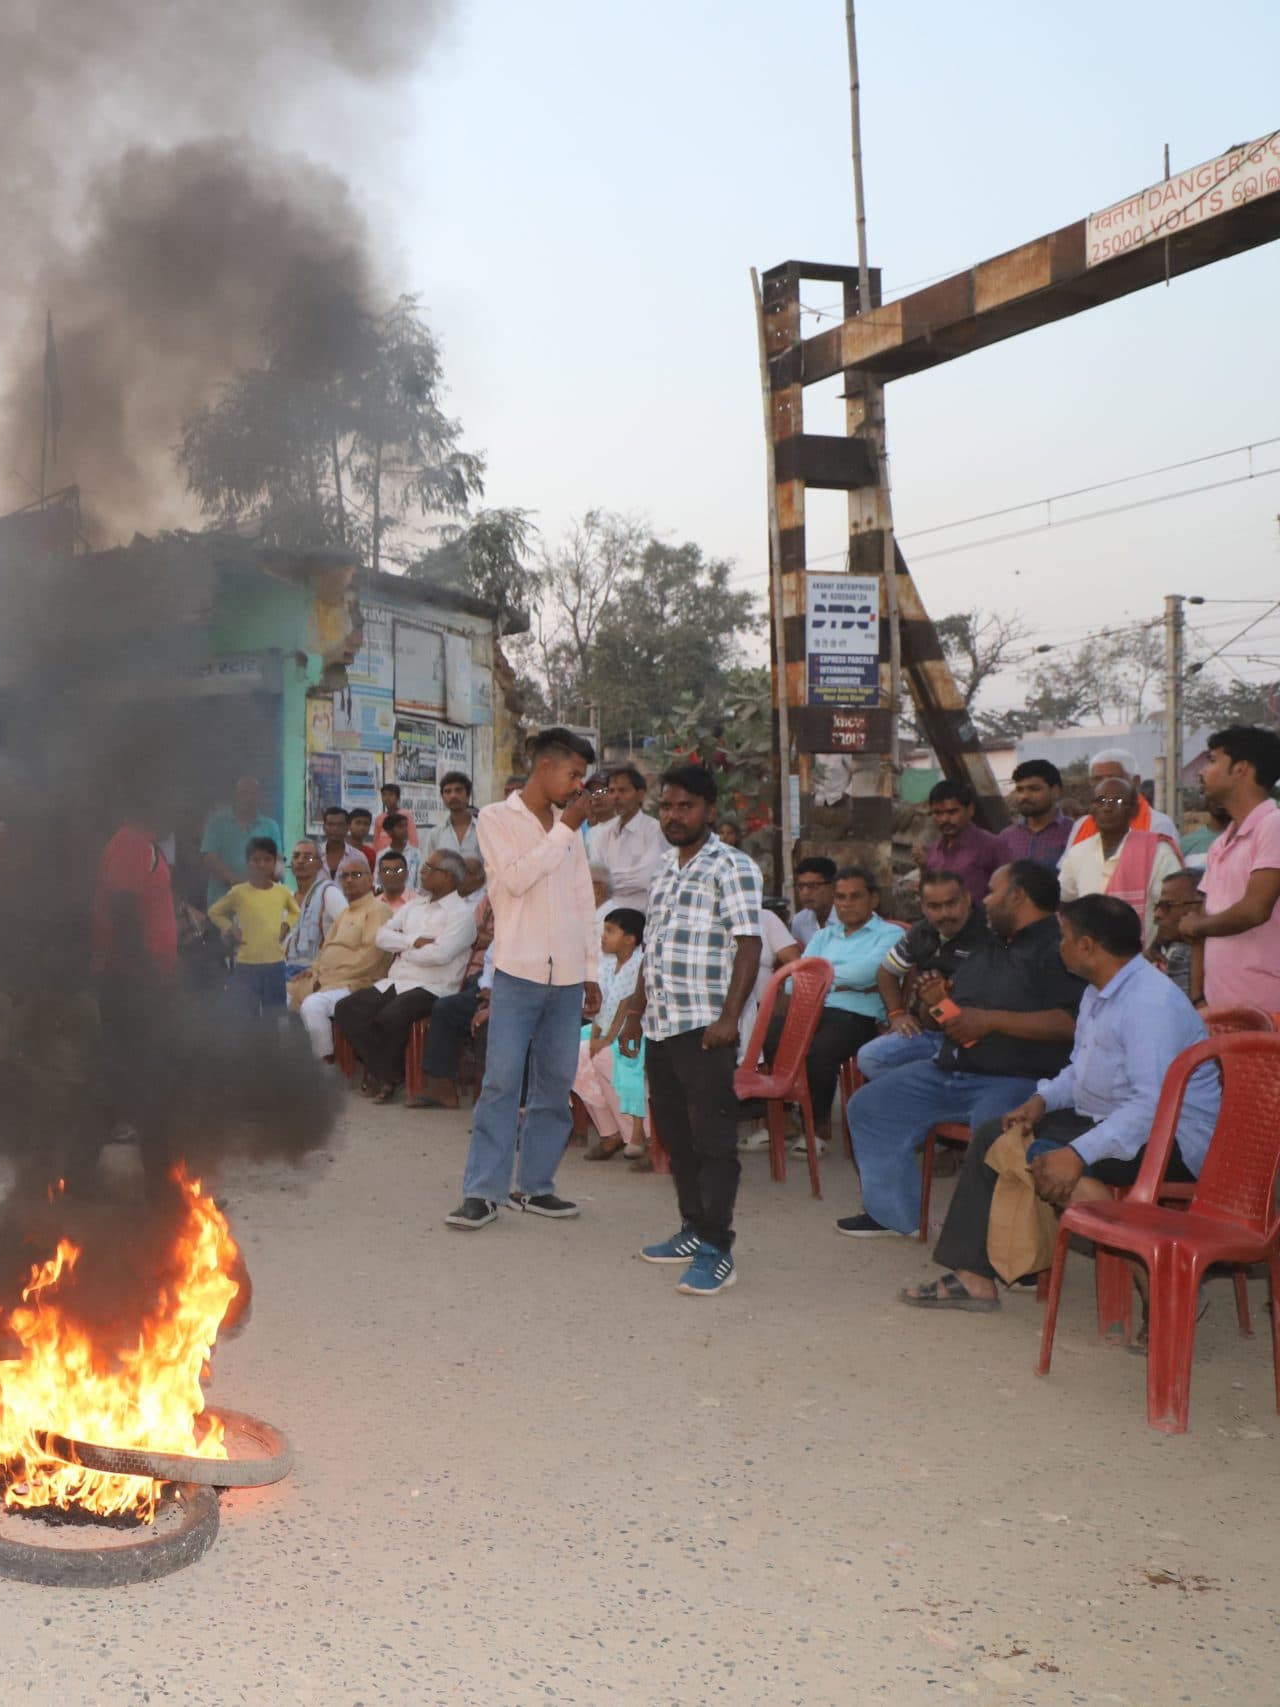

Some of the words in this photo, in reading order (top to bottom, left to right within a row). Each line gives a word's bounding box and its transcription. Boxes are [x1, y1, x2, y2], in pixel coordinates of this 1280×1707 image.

[1148, 154, 1241, 211] DANGER
[1091, 225, 1143, 262] 25000
[1150, 190, 1223, 237] VOLTS
